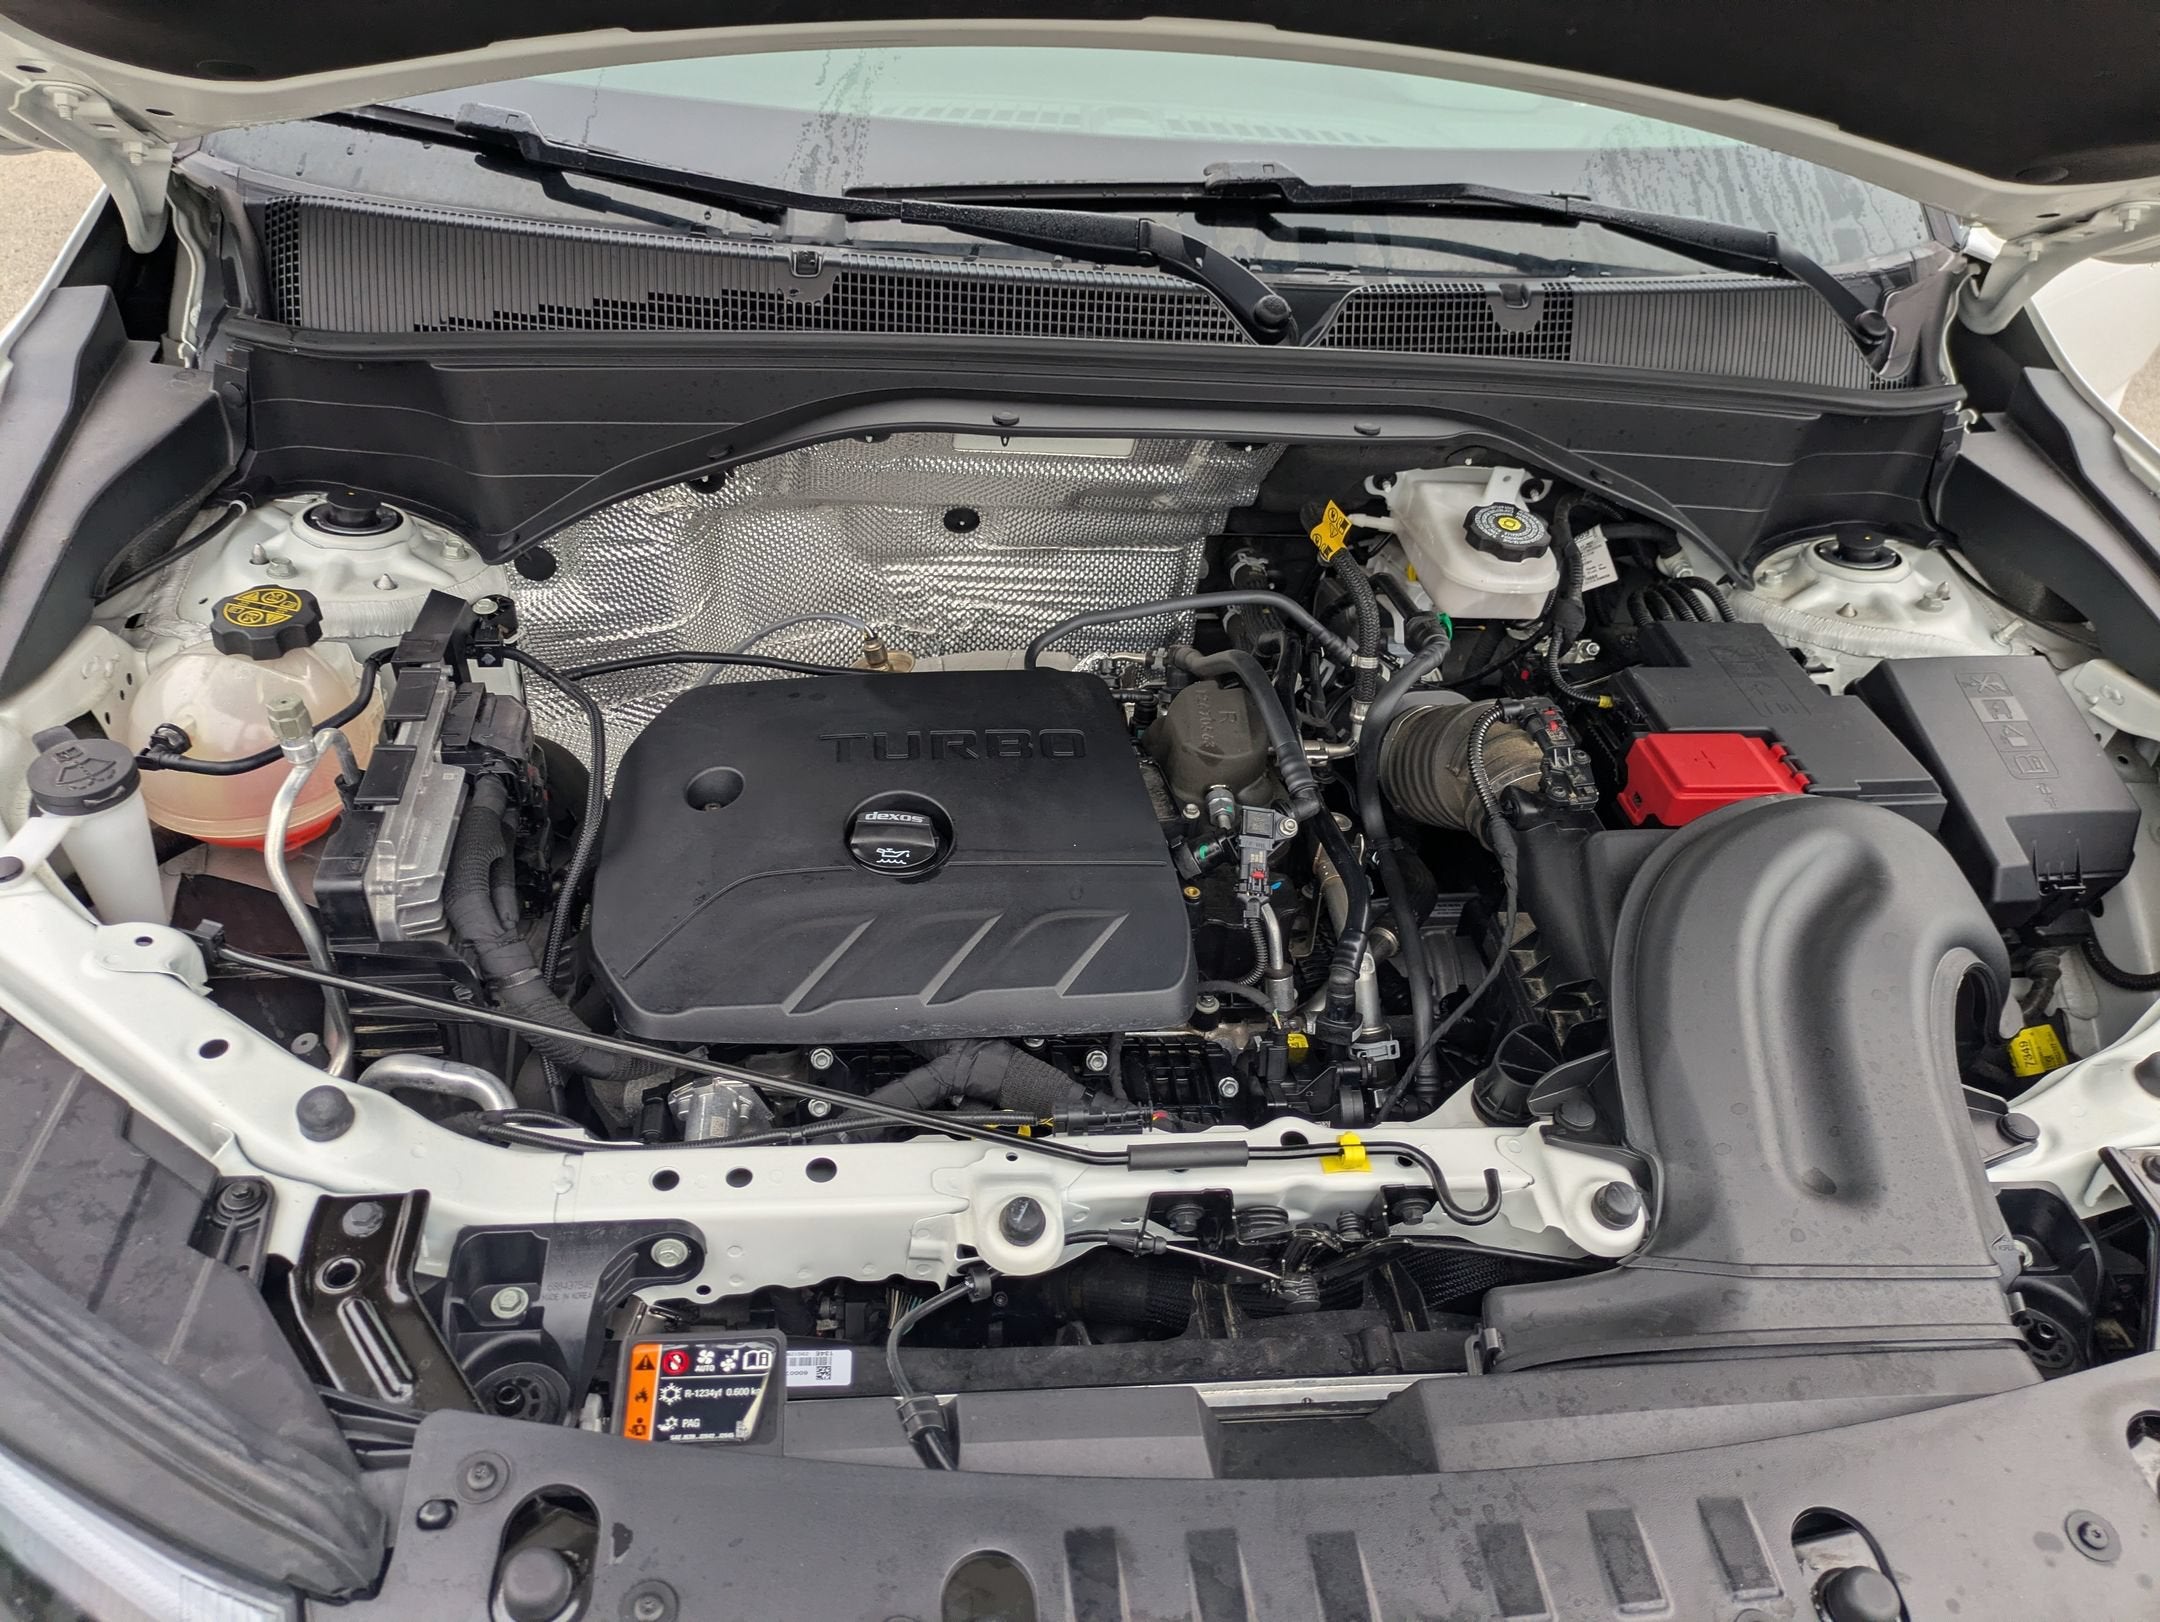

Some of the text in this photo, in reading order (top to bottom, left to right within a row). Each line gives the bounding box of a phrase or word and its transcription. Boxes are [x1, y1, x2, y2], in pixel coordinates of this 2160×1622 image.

[818, 728, 1087, 762] TURBO
[865, 811, 924, 824] dexos
[694, 1364, 716, 1373] AUTO
[684, 1387, 722, 1399] R-1234yf
[725, 1387, 750, 1398] 0.600
[681, 1418, 701, 1428] PAG
